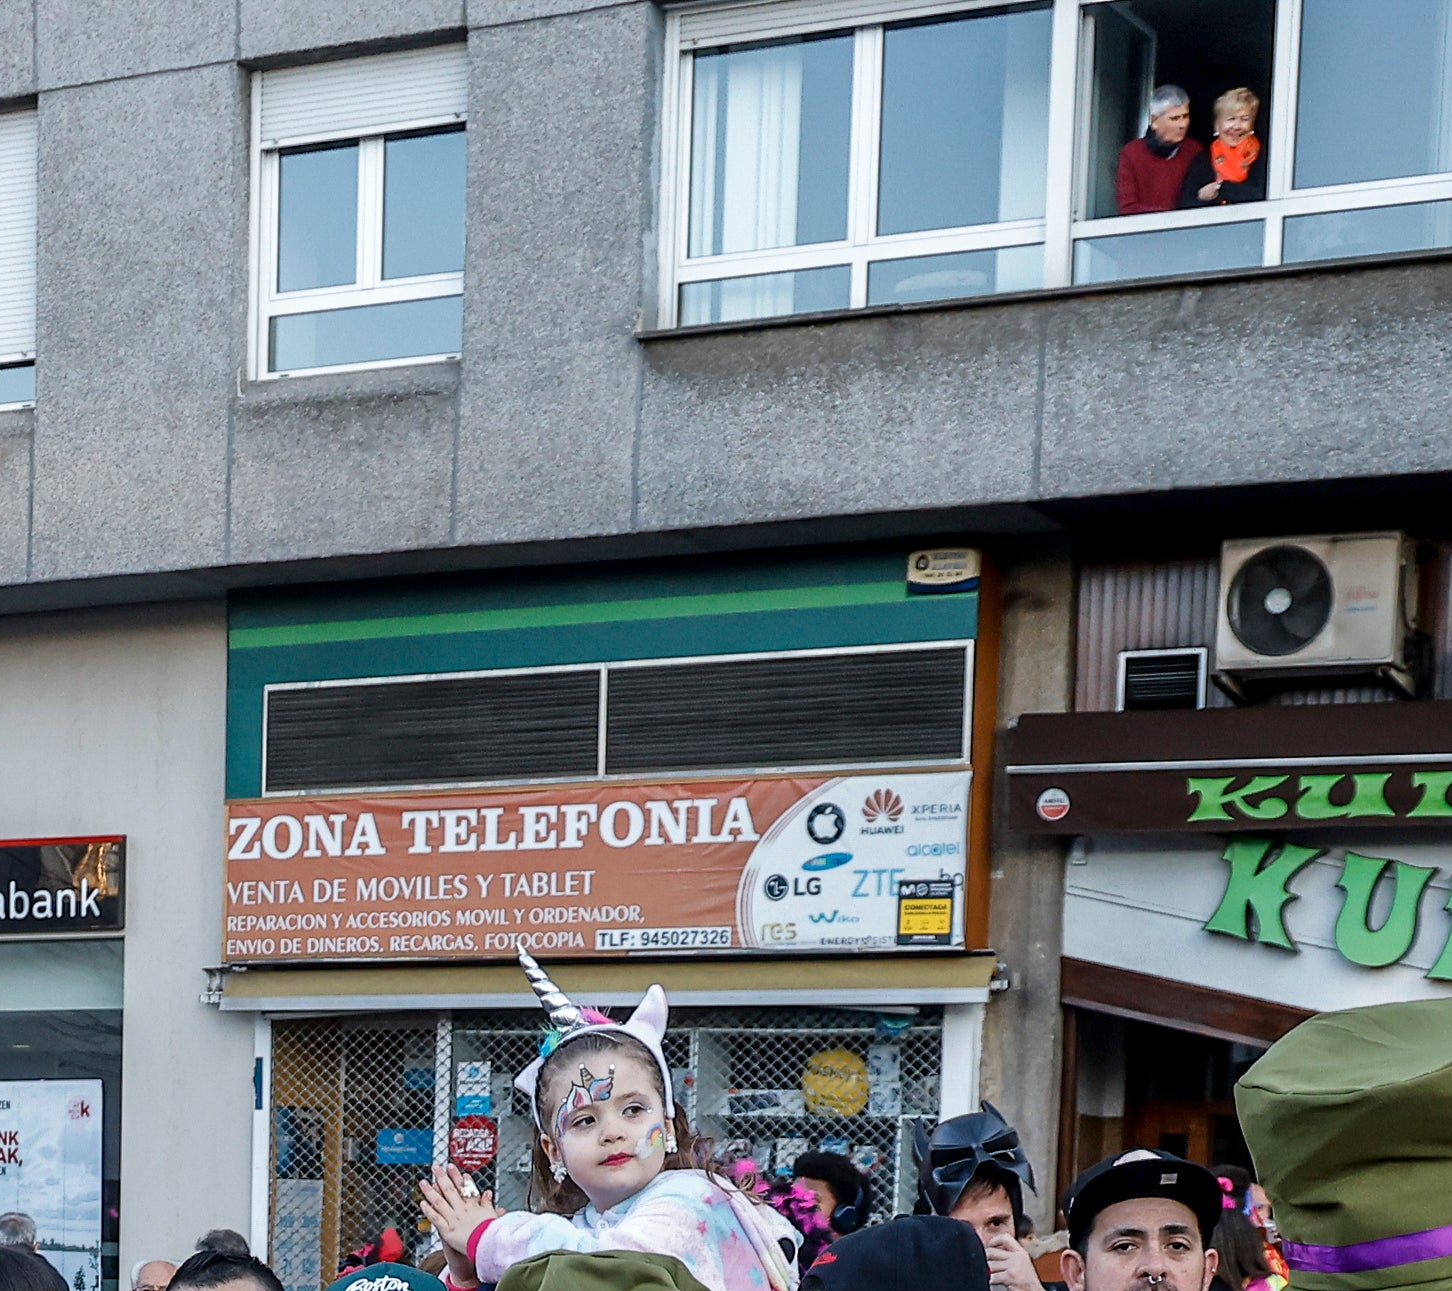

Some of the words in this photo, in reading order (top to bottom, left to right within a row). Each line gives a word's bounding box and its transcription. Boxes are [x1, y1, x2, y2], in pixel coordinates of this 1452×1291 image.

[911, 803, 962, 815] XPERIA
[228, 812, 386, 860] ZONA
[402, 797, 760, 854] TELEFONIA
[861, 825, 904, 834] HUAWEI
[227, 879, 304, 905] VENTA
[313, 877, 347, 904] DE
[356, 873, 468, 902] MOVILES
[475, 873, 494, 898] Y
[500, 870, 596, 898] TABLET
[794, 877, 821, 896] LG
[852, 869, 905, 897] ZTE
[227, 912, 327, 931] REPARACION
[331, 912, 343, 930] Y
[346, 910, 452, 929] ACCESORIOS
[456, 908, 509, 927] MOVIL
[513, 908, 525, 925] Y
[528, 904, 645, 924] ORDENADOR,
[227, 937, 275, 955] ENVIO
[280, 936, 302, 954] DE
[307, 935, 383, 954] DINEROS,
[390, 933, 478, 952] RECARGAS,
[484, 931, 585, 950] FOTOCOPIA
[598, 931, 636, 947] TLF:
[641, 929, 729, 946] 945027326
